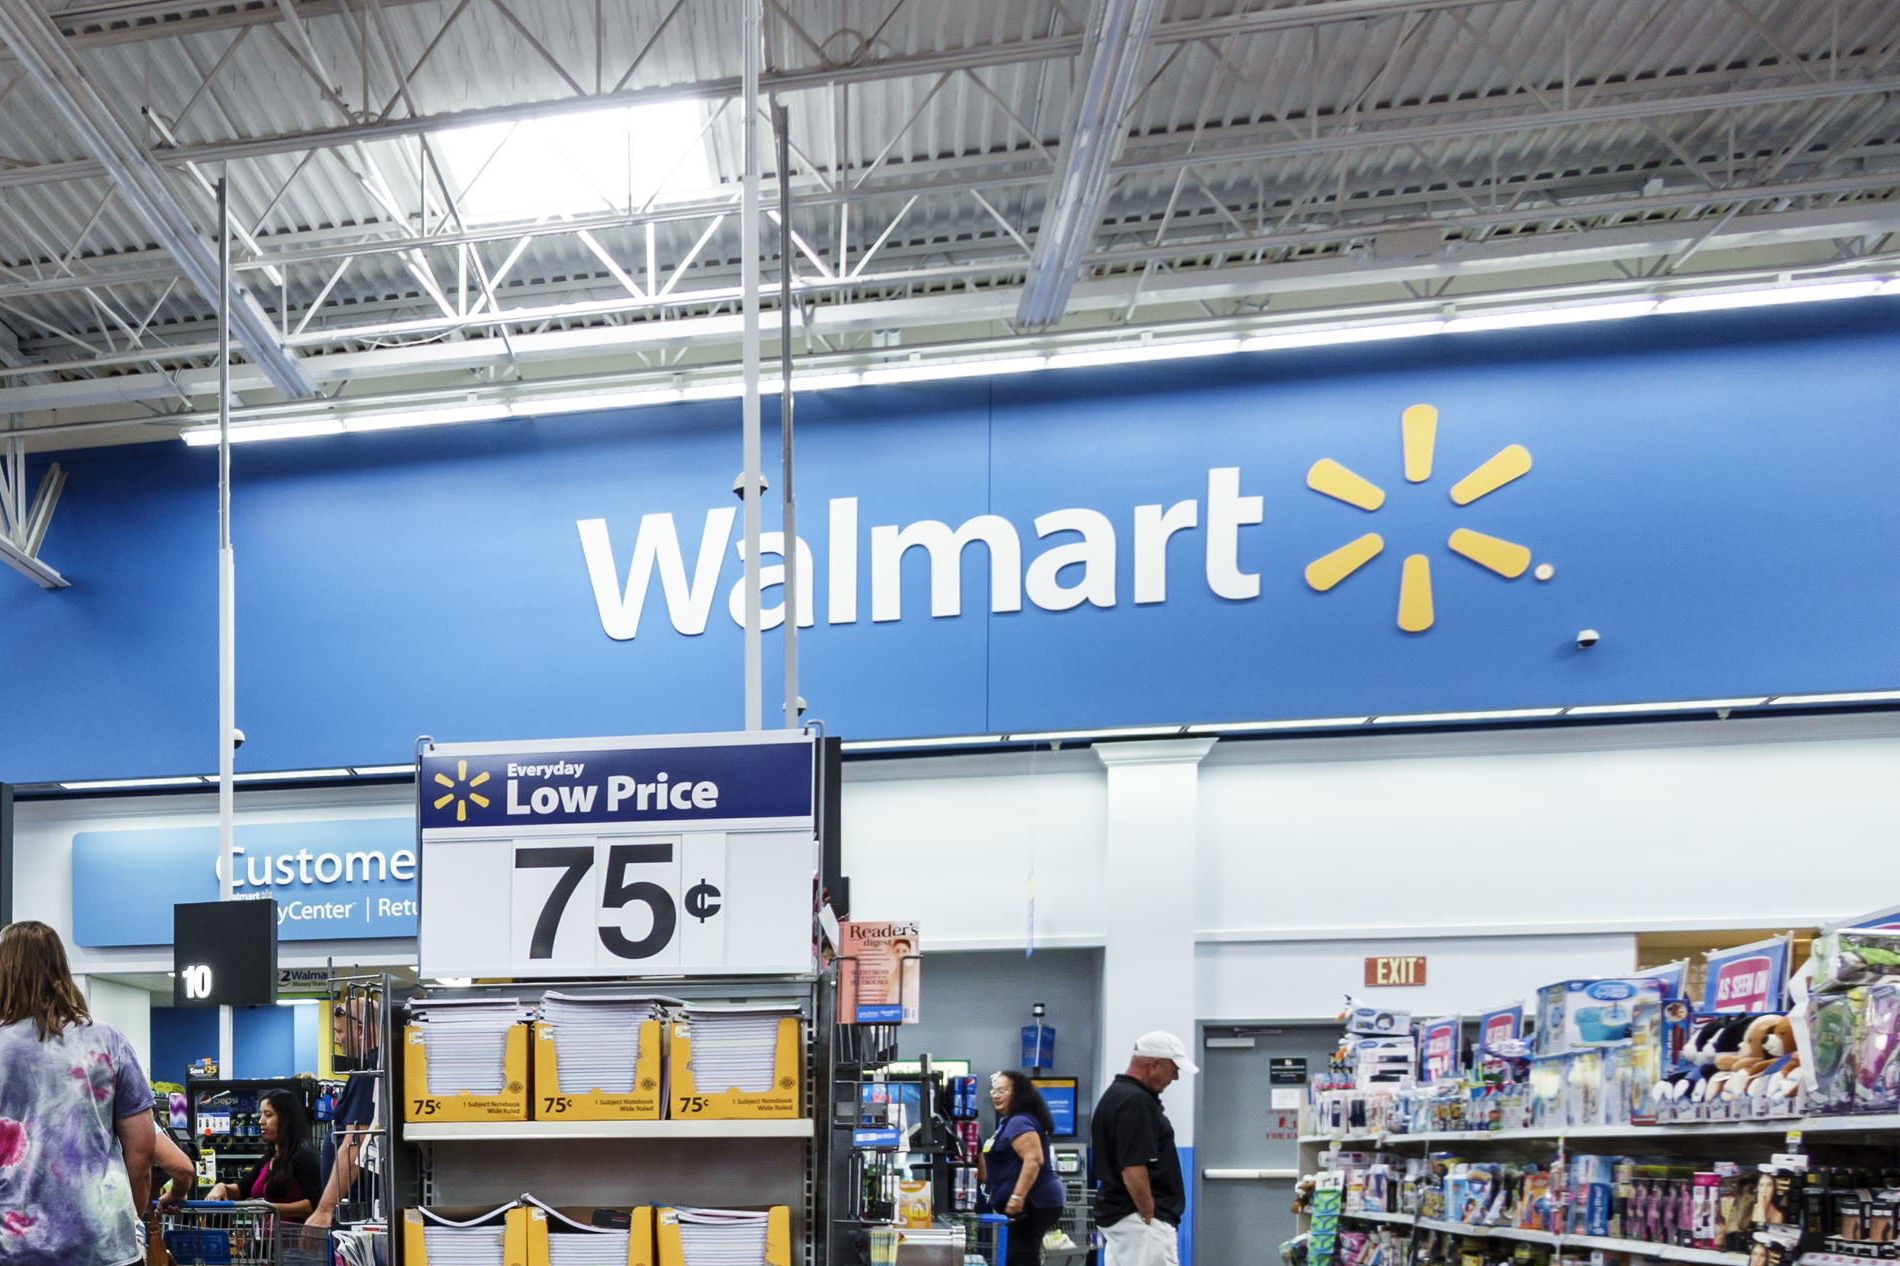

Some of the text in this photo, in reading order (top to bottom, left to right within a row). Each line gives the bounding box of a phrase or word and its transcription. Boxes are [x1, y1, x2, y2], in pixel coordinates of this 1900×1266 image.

[576, 466, 1264, 641] Walmart
[506, 761, 585, 779] Everyday
[506, 772, 719, 815] Low Price
[215, 847, 416, 888] Custome
[232, 891, 260, 901] almart
[514, 843, 722, 960] 75¢
[850, 923, 919, 939] Reader's
[863, 938, 891, 948] digest
[1376, 957, 1417, 985] EXIT
[182, 965, 212, 998] 10
[1731, 974, 1753, 998] SEEN
[189, 1065, 217, 1075] Save $25
[213, 1096, 238, 1106] pepsi
[413, 1099, 441, 1115] 75¢
[544, 1098, 572, 1113] 75¢
[599, 1099, 622, 1107] Subject
[680, 1097, 708, 1112] 75¢
